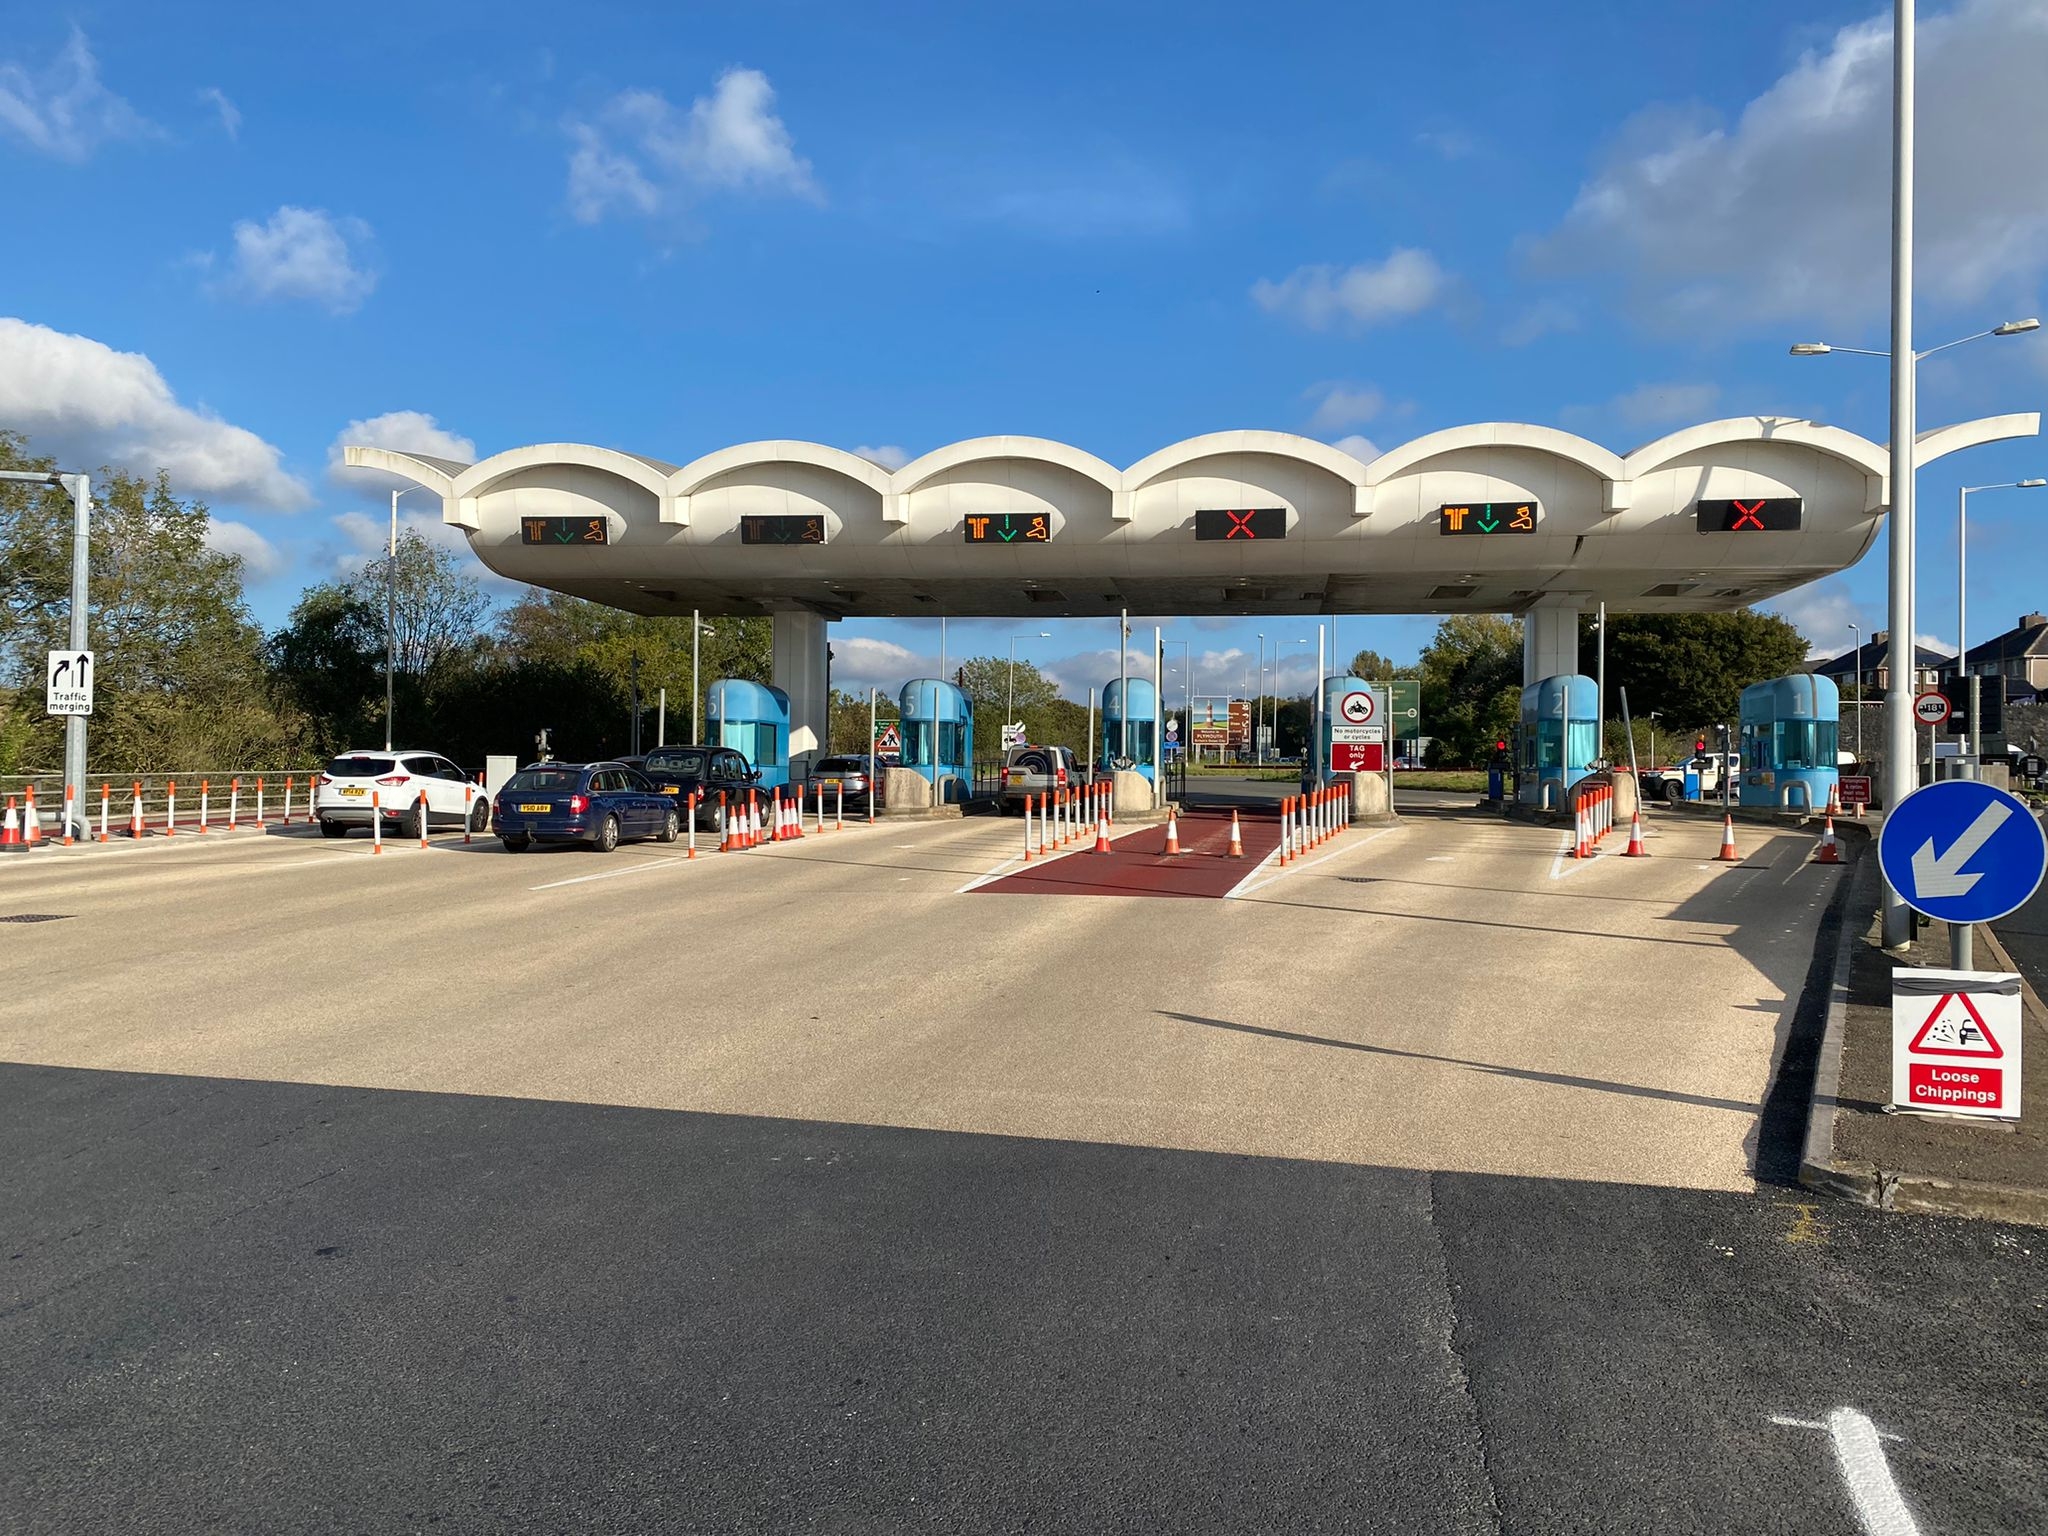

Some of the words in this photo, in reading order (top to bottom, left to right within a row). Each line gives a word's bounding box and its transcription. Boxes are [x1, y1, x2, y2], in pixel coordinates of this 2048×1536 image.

[53, 692, 87, 701] Traffic
[709, 695, 717, 715] 6
[905, 695, 915, 715] 5
[1108, 695, 1120, 715] 4
[1552, 692, 1563, 714] 2
[1793, 693, 1806, 715] 1
[49, 702, 90, 712] merging
[1931, 1069, 1980, 1084] Loose
[1915, 1084, 1996, 1104] Chippings
